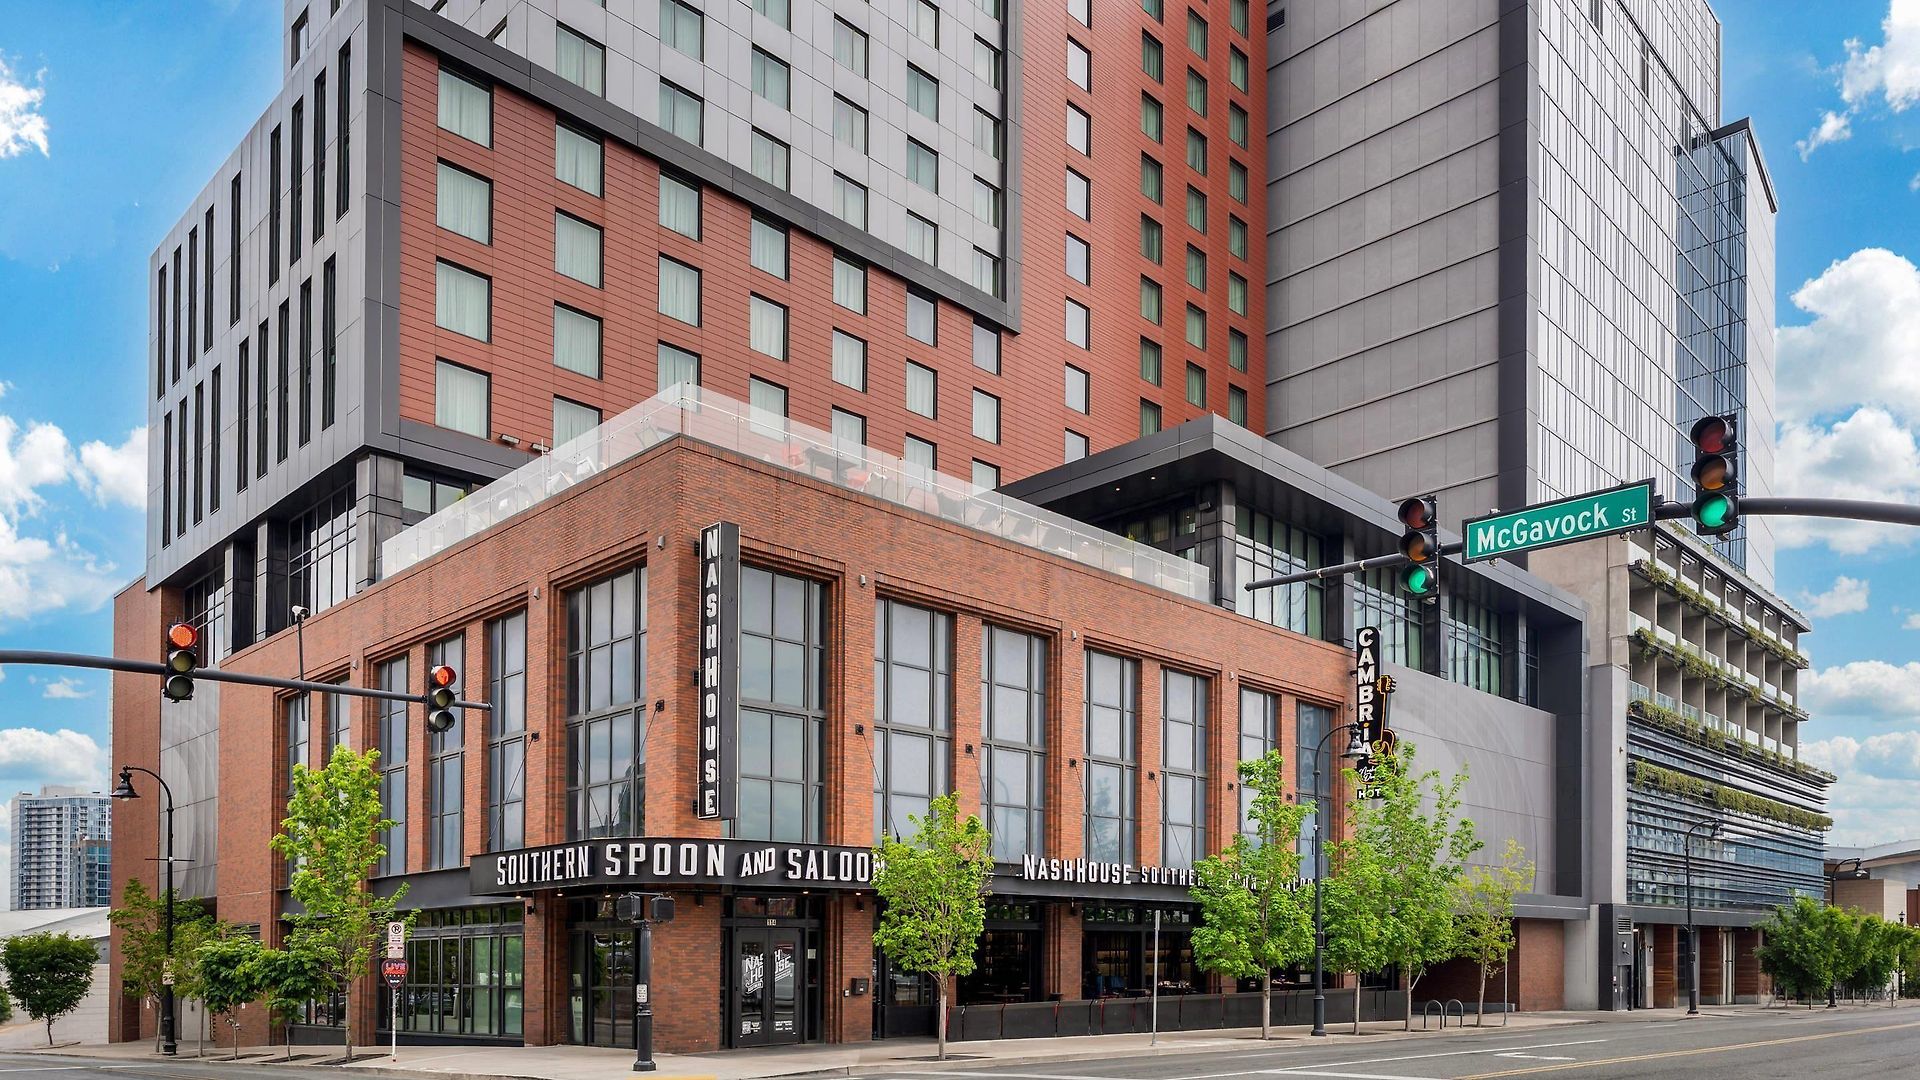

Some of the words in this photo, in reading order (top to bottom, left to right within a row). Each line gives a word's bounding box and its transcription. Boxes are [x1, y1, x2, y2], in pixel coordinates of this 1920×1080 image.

[1477, 502, 1609, 553] McGavock
[1621, 507, 1637, 523] St
[705, 528, 718, 815] NASHHOUSE
[497, 845, 589, 886] SOUTHERN
[605, 843, 726, 877] SPOON
[740, 847, 776, 878] AND
[1023, 853, 1132, 885] NASHHOUSE
